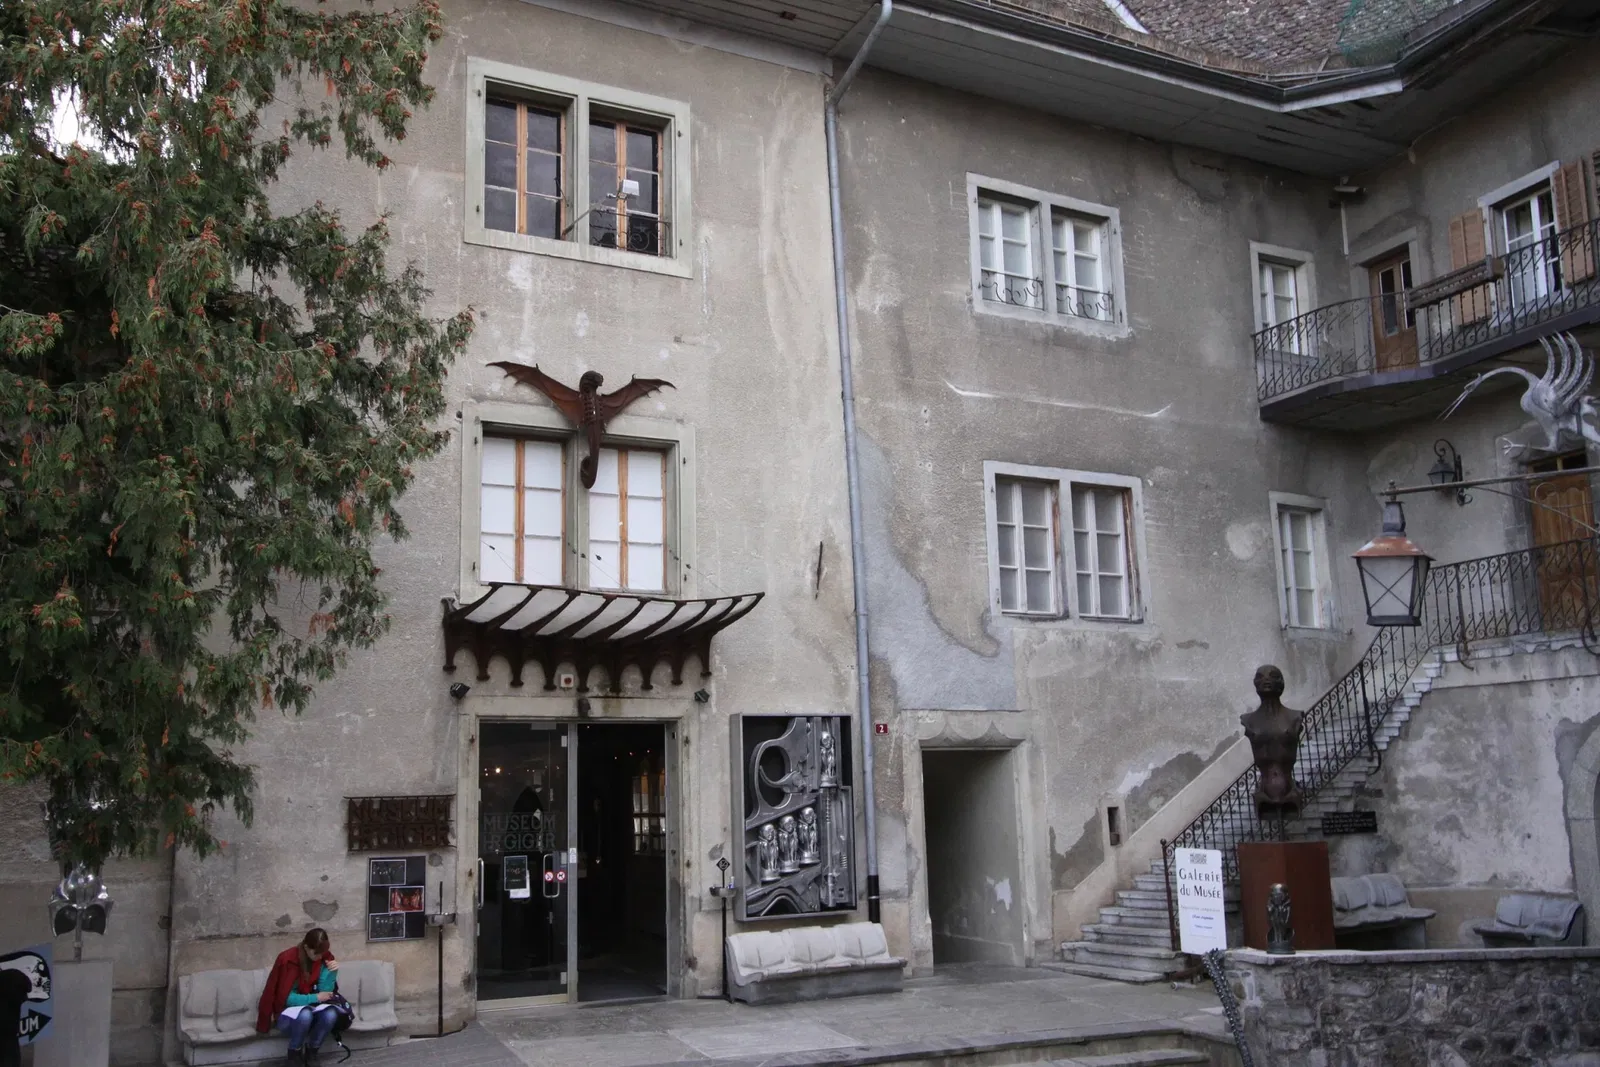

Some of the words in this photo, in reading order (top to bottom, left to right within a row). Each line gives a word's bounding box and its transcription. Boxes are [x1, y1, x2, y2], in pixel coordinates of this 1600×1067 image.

[879, 724, 884, 732] 2
[348, 797, 451, 822] MUSEUM
[484, 814, 556, 832] MUSEUM
[504, 832, 556, 849] GIGER
[1180, 884, 1191, 896] du
[17, 1015, 39, 1036] UM
